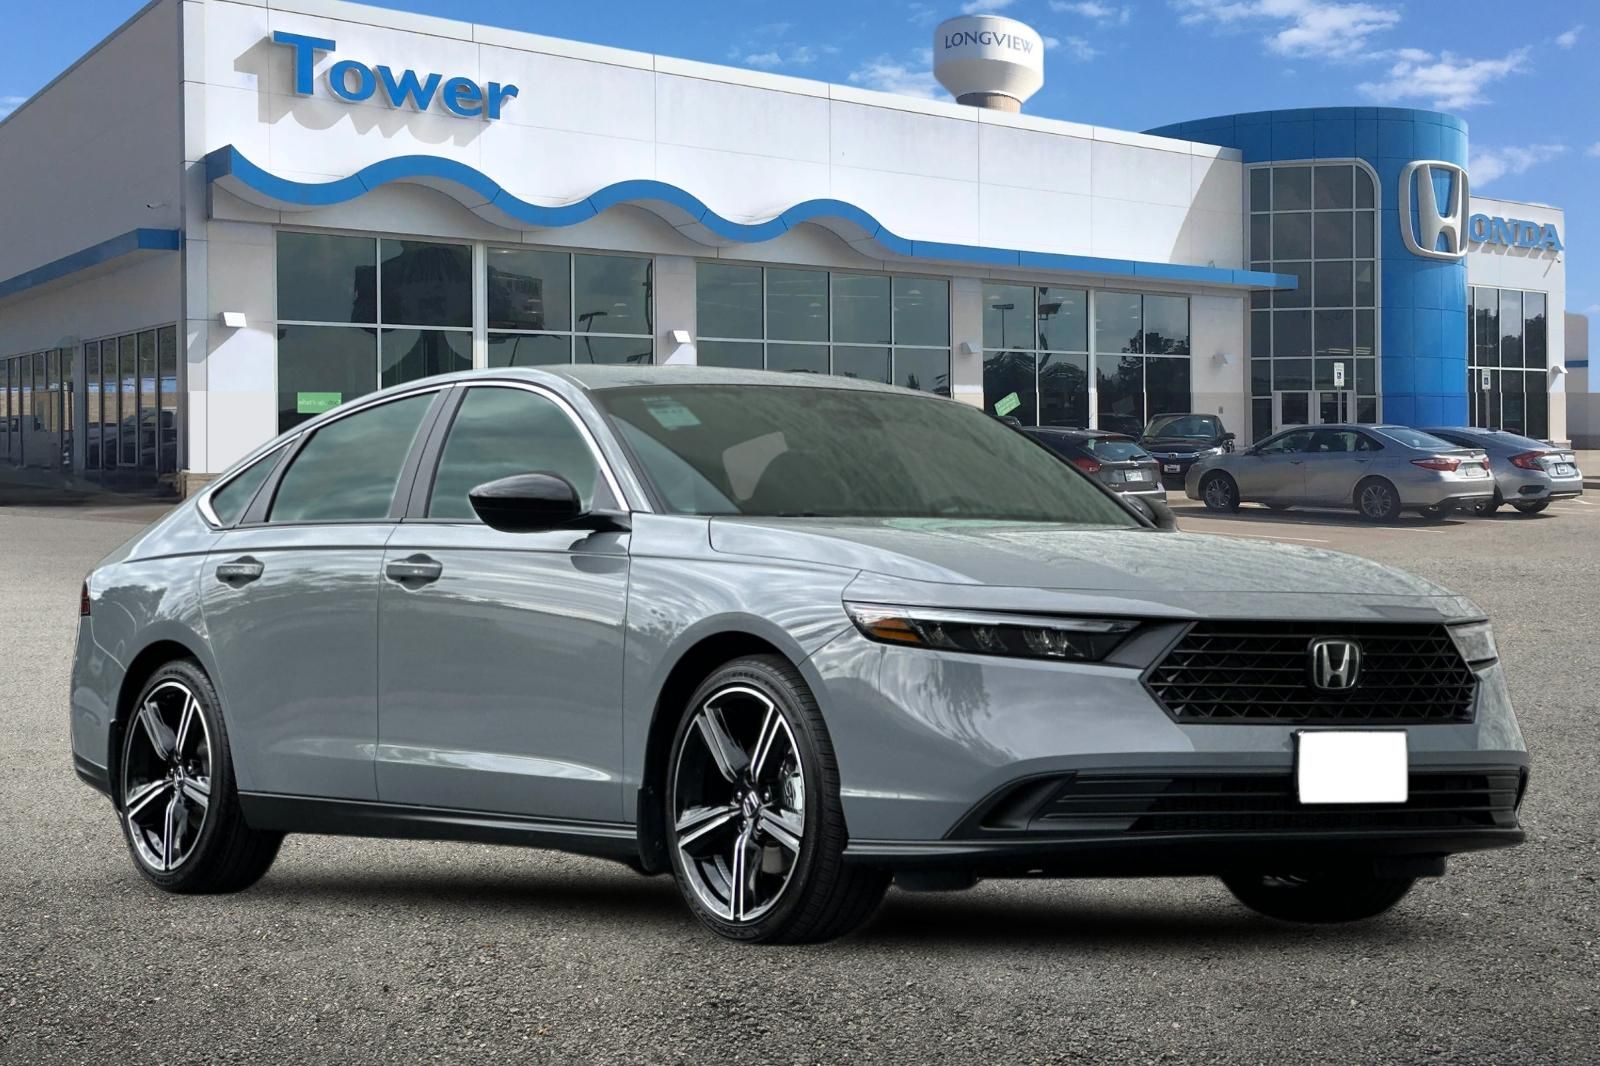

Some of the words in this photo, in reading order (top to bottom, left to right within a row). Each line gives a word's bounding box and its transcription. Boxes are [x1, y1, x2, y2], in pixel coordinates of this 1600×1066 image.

[945, 31, 1033, 54] LONGVIEW
[273, 30, 519, 120] Tower
[1469, 213, 1564, 251] ONDA
